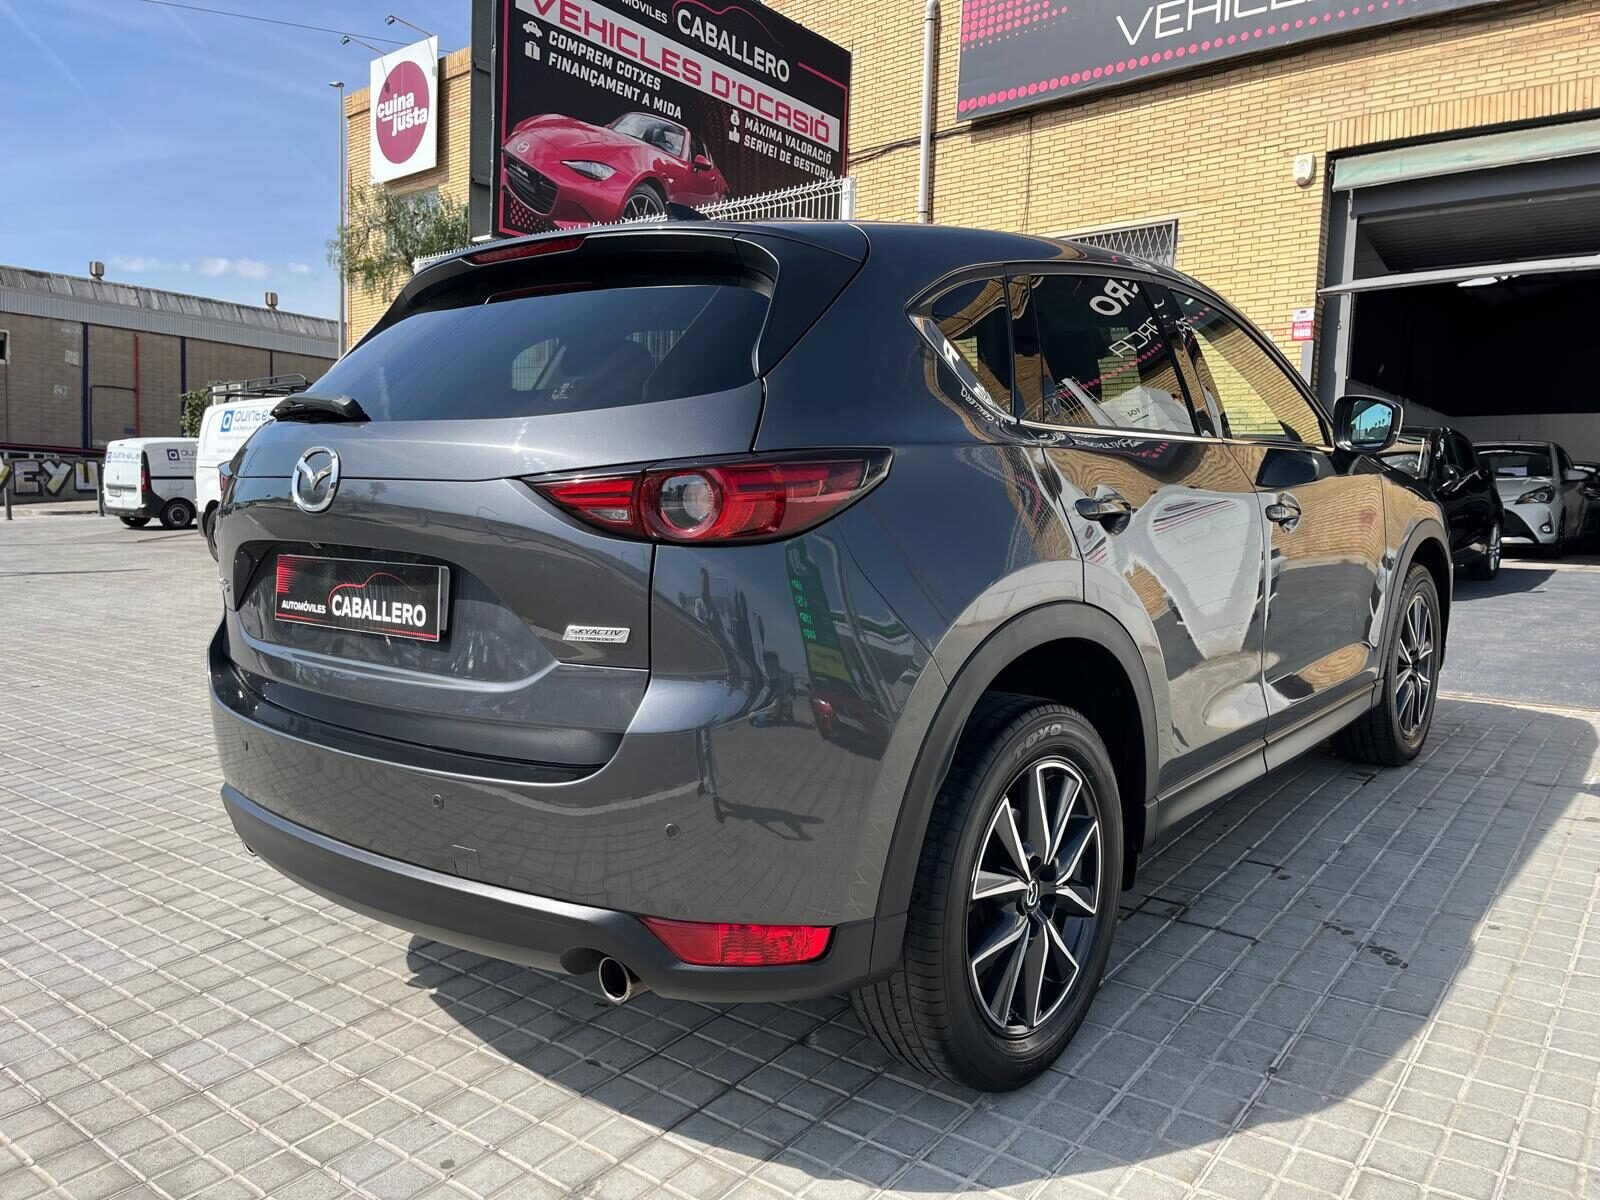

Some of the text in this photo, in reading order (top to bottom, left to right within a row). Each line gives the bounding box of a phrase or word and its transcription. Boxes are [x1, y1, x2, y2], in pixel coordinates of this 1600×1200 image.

[549, 30, 662, 91] COMPREM COTXES
[677, 9, 790, 82] CABALLERO
[533, 0, 830, 143] VEHICLES D'OCASIÓ
[548, 52, 682, 119] FINANÇAMENT A MIDA
[377, 91, 415, 118] cuina
[391, 106, 428, 137] justa
[743, 134, 778, 159] SERVEI
[779, 149, 792, 164] DE
[744, 117, 832, 165] MÀXIMA VALORACIÓ
[281, 594, 427, 627] AUTOMÓVILES CABALLERO
